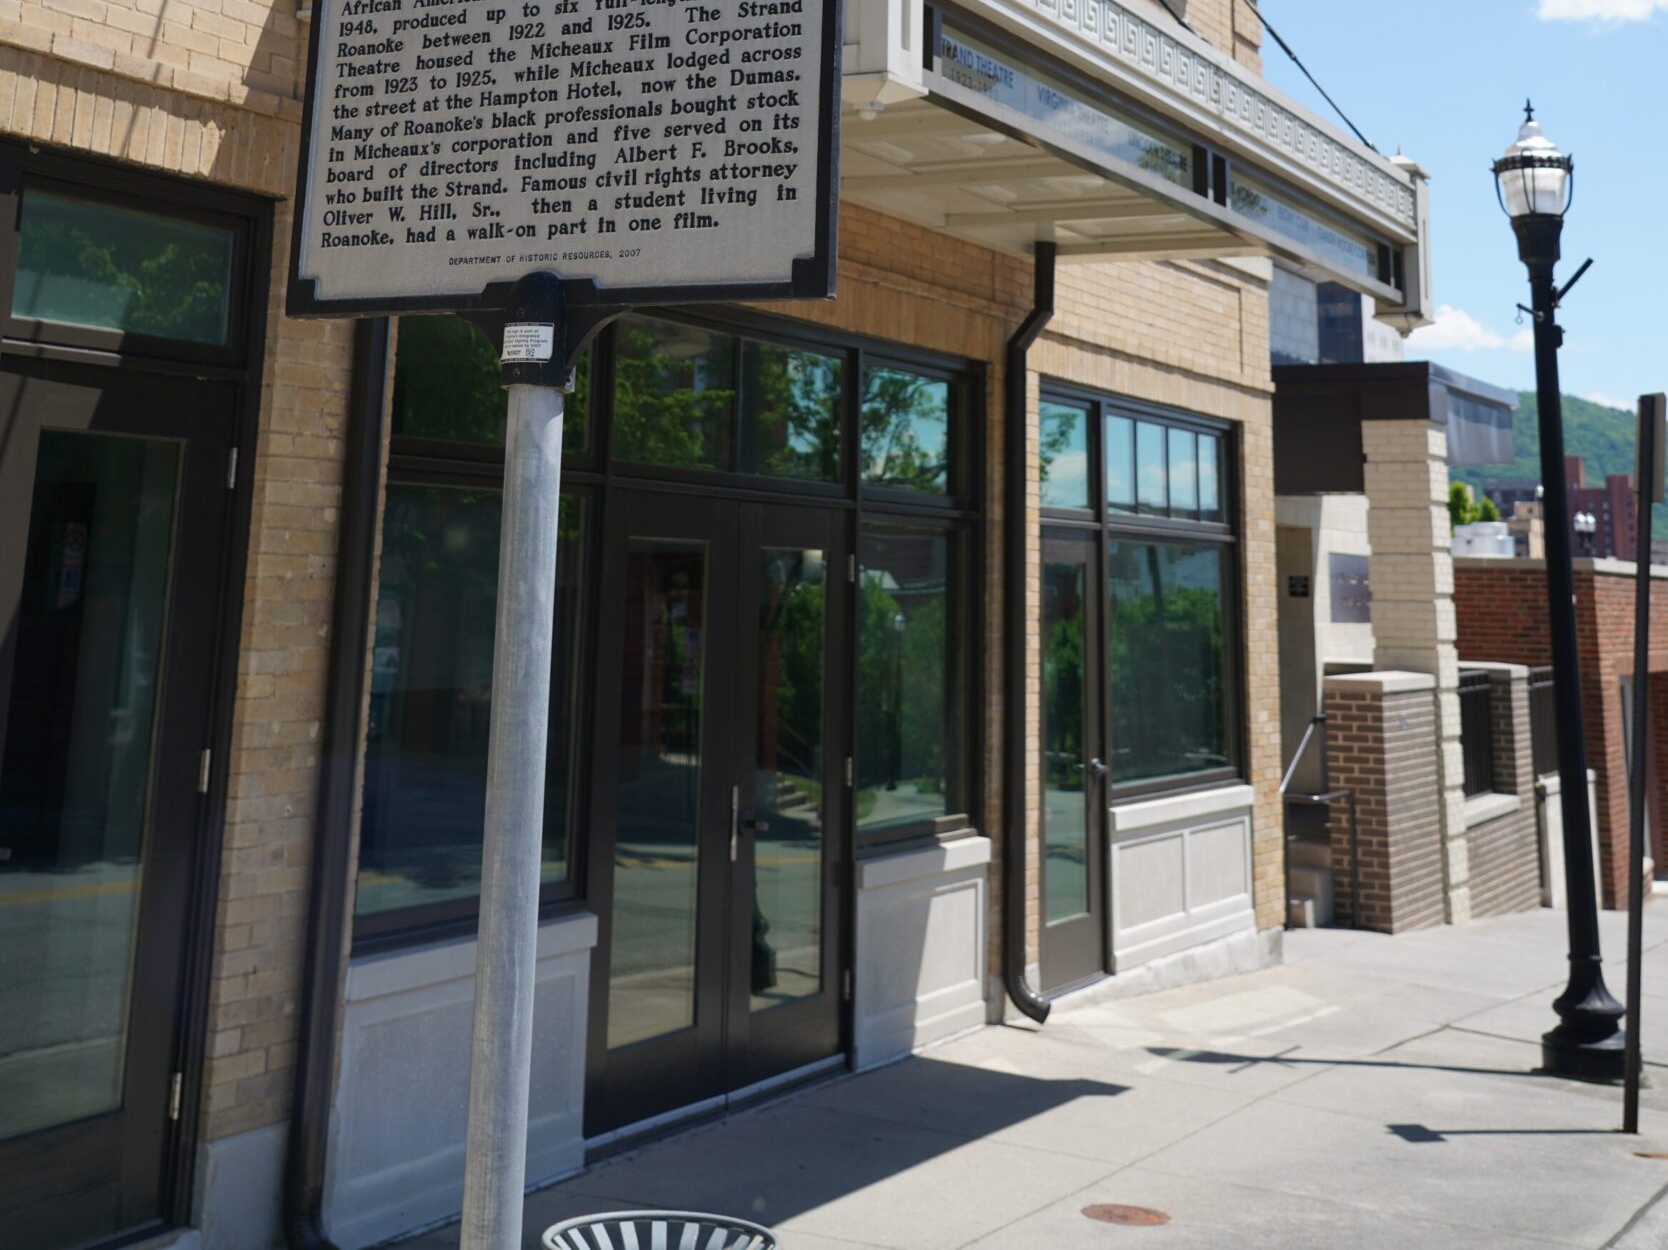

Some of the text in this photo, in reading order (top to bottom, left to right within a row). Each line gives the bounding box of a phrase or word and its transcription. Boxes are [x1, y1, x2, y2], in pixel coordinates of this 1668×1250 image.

[336, 37, 404, 58] Roanoke
[421, 31, 491, 50] between
[508, 21, 545, 41] 1922
[560, 16, 593, 36] and
[607, 11, 651, 31] 1925.
[684, 5, 721, 24] The
[338, 19, 378, 37] 1948,
[391, 8, 467, 36] produced
[485, 8, 506, 25] up
[521, 1, 540, 18] to
[334, 46, 802, 99] from 1923 to 1925, while Micheaux lodged across
[335, 21, 802, 78] Theatre housed the Micheaux Film Corporation
[941, 38, 973, 68] TRAND
[330, 88, 800, 143] Many of Roanoke's black professionals bought stock
[332, 68, 801, 120] the street at the Hampton Hotel, now the Dumas.
[325, 136, 799, 184] board of directors including Albert F. Brooks,
[328, 112, 800, 163] in Micheaux's corporation and five served on its
[322, 209, 374, 227] Oliver
[387, 205, 406, 223] W.
[418, 202, 457, 221] Hill,
[530, 197, 572, 214] then
[587, 198, 598, 211] a
[613, 189, 686, 210] student
[700, 186, 758, 207] living
[776, 183, 797, 201] in
[325, 162, 798, 205] who built the Strand. Famous civil rights attorney
[320, 211, 719, 248] Roanoke, had a walk-on part in one film.
[448, 247, 641, 266] DEPARTMENT OF HISTORIC RESOURCES, 2007
